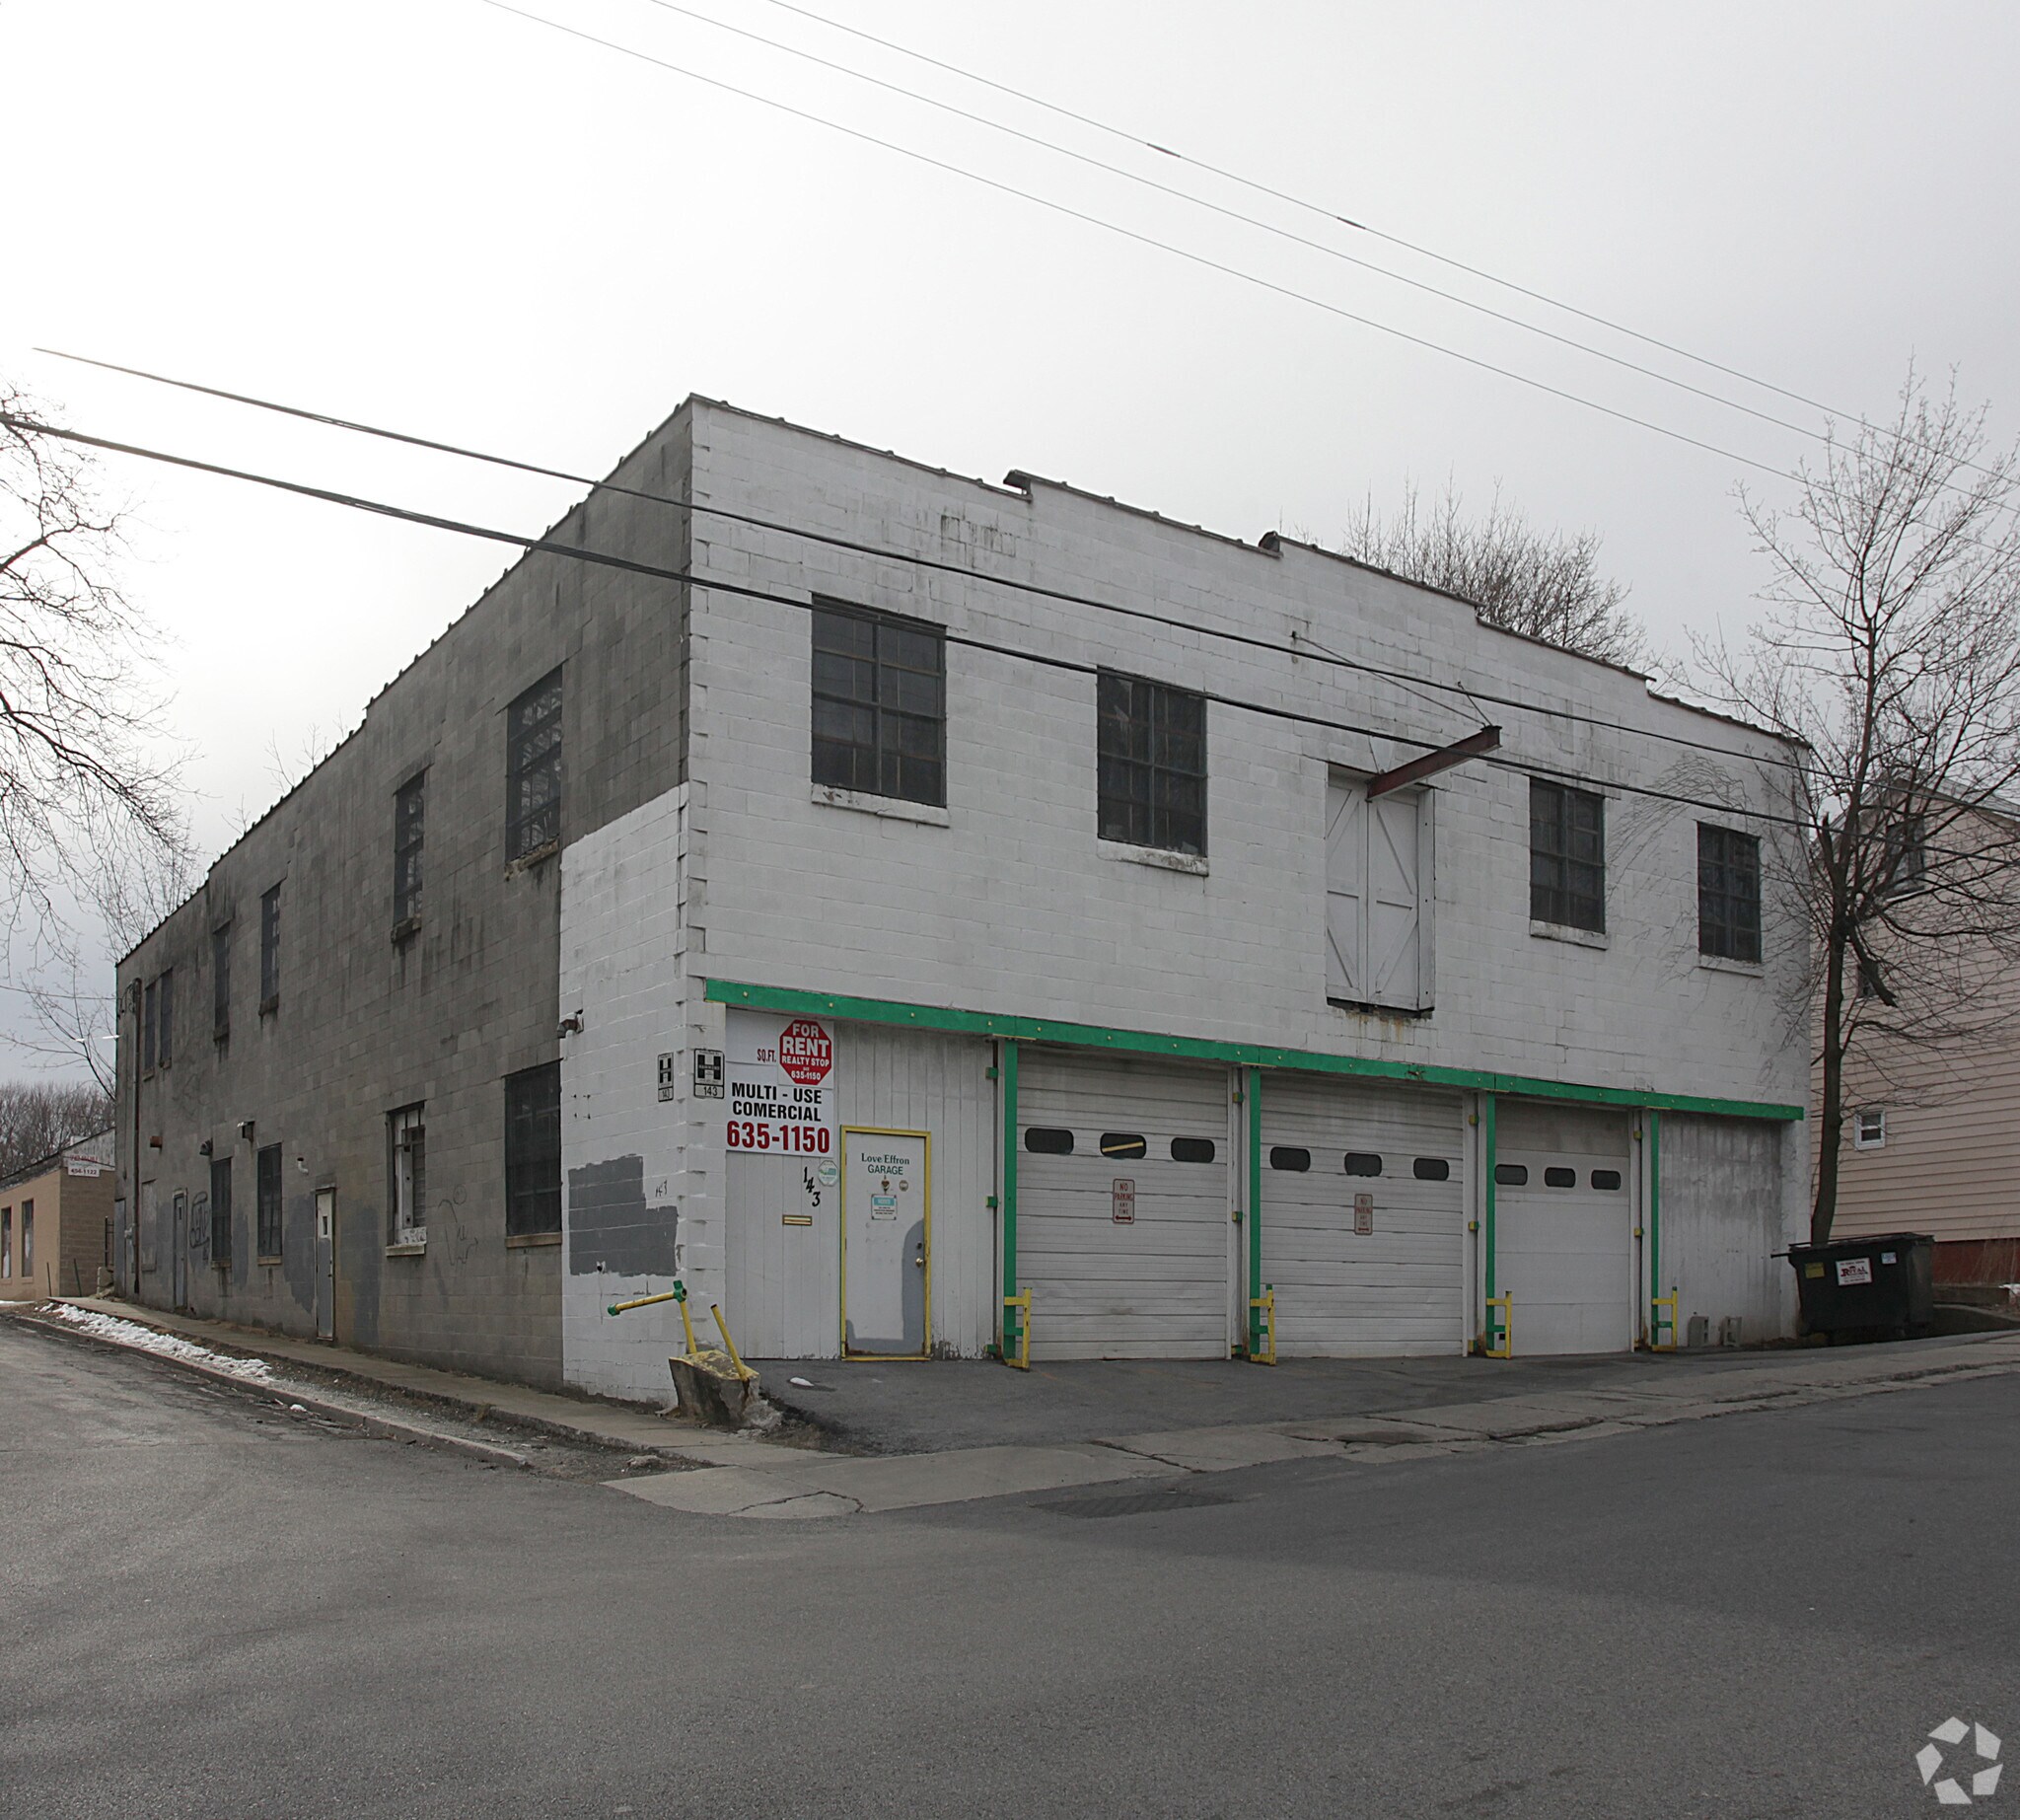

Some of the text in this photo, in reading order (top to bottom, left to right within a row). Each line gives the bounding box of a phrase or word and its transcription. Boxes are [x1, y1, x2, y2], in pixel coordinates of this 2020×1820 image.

[792, 1023, 820, 1038] FOR
[782, 1036, 830, 1057] RENT
[781, 1055, 830, 1068] REALTY STOP
[790, 1070, 822, 1081] 635-1150
[703, 1086, 718, 1097] 143
[732, 1082, 777, 1101] MULTI
[793, 1088, 823, 1105] USE
[733, 1100, 822, 1123] COMERCIAL
[727, 1121, 830, 1154] 635-1150
[861, 1152, 910, 1165] Love Effron
[868, 1164, 903, 1176] GARAGE
[1119, 1183, 1129, 1193] NO
[1115, 1192, 1134, 1201] PARKING
